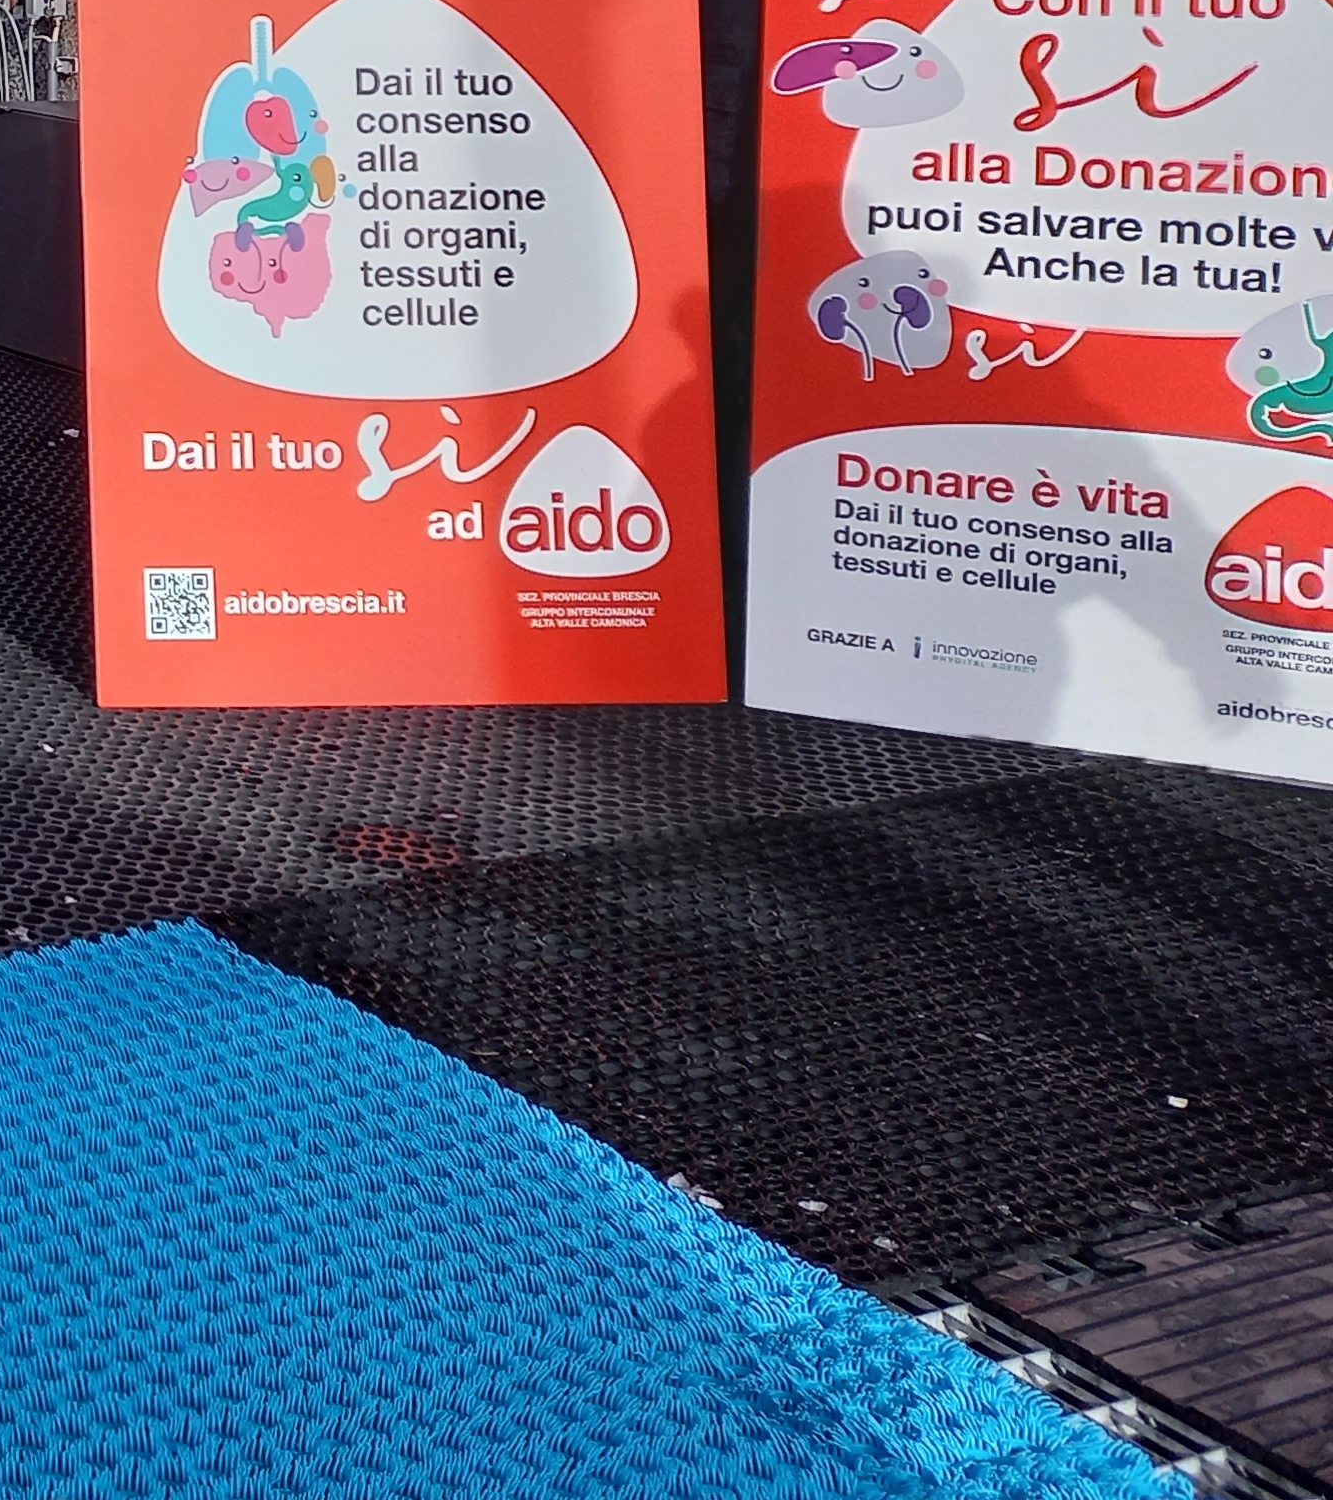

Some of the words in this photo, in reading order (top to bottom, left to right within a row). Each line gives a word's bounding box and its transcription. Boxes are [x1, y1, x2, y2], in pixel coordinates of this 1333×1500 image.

[355, 68, 416, 97] Dai
[425, 68, 446, 97] il
[454, 70, 514, 97] tuo
[356, 108, 531, 135] consenso
[357, 145, 419, 173] alla
[911, 143, 1012, 184] alla
[1034, 145, 1333, 198] Donazion
[358, 182, 547, 212] donazione
[359, 221, 393, 250] di
[403, 220, 528, 258] organi,
[867, 202, 962, 235] puoi
[978, 205, 1143, 242] salvare
[1159, 215, 1297, 250] molte
[360, 260, 483, 289] tessuti
[493, 267, 515, 289] e
[984, 247, 1125, 284] Anche
[1141, 254, 1178, 287] la
[1196, 259, 1283, 293] tua!
[362, 298, 479, 327] cellule
[143, 432, 217, 470] Dai
[231, 432, 255, 470] il
[268, 437, 344, 470] tuo
[837, 453, 1015, 503] Donare
[1032, 468, 1061, 508] è
[1078, 478, 1169, 519] vita
[427, 502, 483, 540] ad
[506, 488, 663, 554] aido
[834, 499, 879, 523] Dai
[889, 504, 903, 525] il
[912, 507, 958, 531] tuo
[968, 516, 1110, 547] consenso
[1120, 530, 1174, 554] alla
[833, 525, 981, 559] donazione
[990, 542, 1015, 564] di
[1025, 548, 1127, 580] organi,
[833, 551, 927, 580] tessuti
[936, 565, 953, 582] e
[962, 568, 1057, 594] cellule
[224, 589, 406, 616] aidobrescia.it
[543, 592, 611, 602] PROVINCIALE
[613, 591, 661, 601] BRESCIA
[521, 607, 565, 617] GRUPPO
[567, 607, 655, 617] INTERCOMUNALE
[530, 619, 556, 628] ALTA
[558, 619, 589, 628] VALLE
[591, 618, 647, 628] CAMONICA
[807, 628, 877, 650] GRAZIE
[881, 638, 895, 652] A
[932, 640, 1038, 666] innovazione
[1251, 633, 1330, 650] PROVINCIALE
[1226, 644, 1275, 658] GRUPPO
[1278, 650, 1333, 666] INTERCO
[1236, 656, 1263, 667] ALTA
[1266, 660, 1303, 672] VALLE
